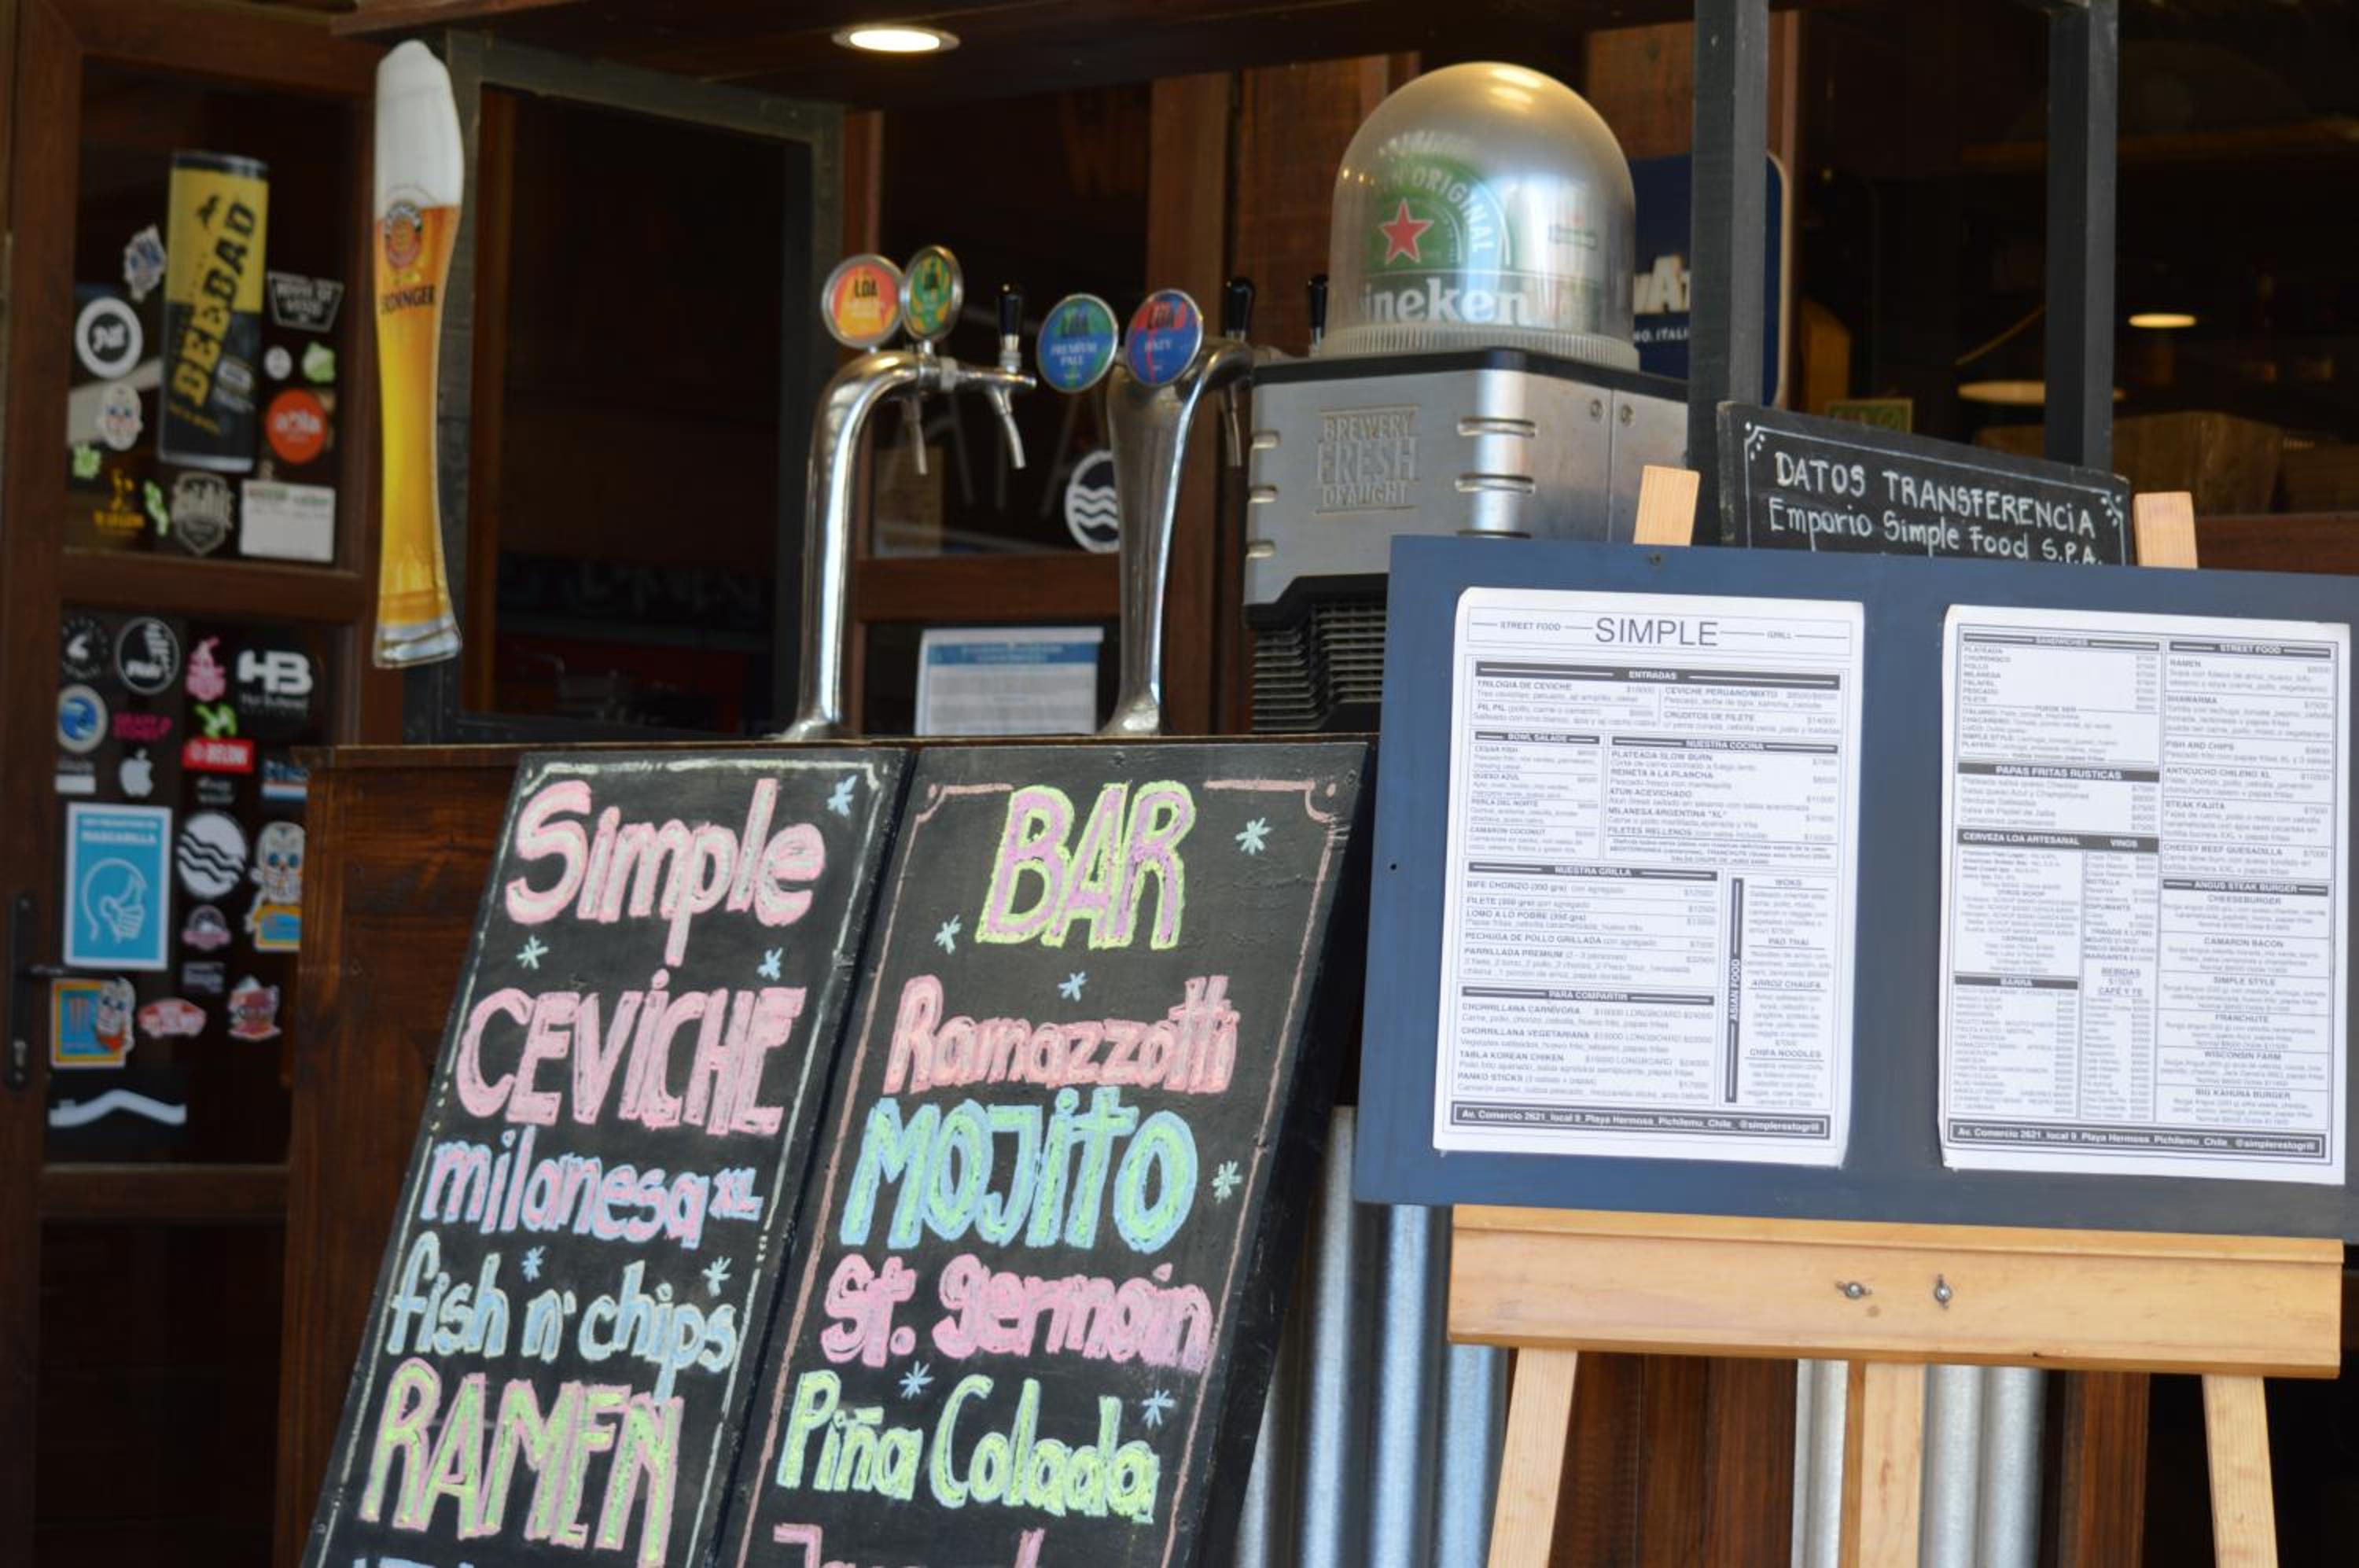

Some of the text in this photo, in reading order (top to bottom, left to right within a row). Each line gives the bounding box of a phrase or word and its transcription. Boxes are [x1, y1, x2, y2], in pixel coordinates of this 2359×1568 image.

[1411, 167, 1493, 252] ORIGINAL
[854, 278, 878, 299] LOA
[1323, 412, 1411, 441] BREWERY
[1316, 436, 1419, 484] FRESH
[1775, 451, 1866, 498] DATOS
[1322, 481, 1409, 506] DRAUGHT
[1883, 510, 1960, 558] Simple
[1970, 526, 2029, 561] Food
[1500, 621, 1533, 631] STREET
[1536, 622, 1560, 631] FOOD
[1595, 617, 1720, 646] SIMPLE
[2219, 644, 2282, 654] STREET FOOD
[1628, 670, 1678, 681] ENTRADAS
[1534, 683, 1573, 691] CEVICHE
[1665, 687, 1703, 696] CEVICHE
[1685, 741, 1765, 751] NUESTRA COCINA
[2208, 742, 2235, 751] CHIPS
[1671, 771, 1714, 780] PLANCHA
[1996, 765, 2122, 780] PAPAS FRITAS RUSTICAS
[2166, 767, 2217, 776] ANTICUCHO
[1963, 832, 2139, 848] CERVEZA LOA ARTESANAL VINOS
[505, 777, 826, 966] Simple
[975, 780, 1196, 951] BAR
[1555, 867, 1632, 878] NUESTRA GRILLA
[2195, 882, 2298, 893] ANGUS STEAK BURGER
[2207, 895, 2281, 904] CHEESEBURGER
[1525, 934, 1554, 943] POLLO
[1556, 936, 1601, 945] GRILLADA
[2204, 937, 2284, 948] CAMARON BACON
[1730, 958, 1740, 990] FOOD
[2214, 977, 2276, 986] SIMPLE STYLE
[1549, 990, 1628, 1001] PARA COMPARTIR
[882, 974, 1241, 1095] Ramazzotti
[2252, 1091, 2291, 1100] BURGER
[1478, 1110, 1522, 1121] Comercio
[1585, 1113, 1610, 1125] Playa
[1974, 1128, 2018, 1139] Comercio
[2081, 1133, 2106, 1143] Playa
[419, 1125, 710, 1249] milanesa
[385, 1231, 510, 1358] fish
[578, 1259, 738, 1406] chips
[776, 1370, 1161, 1524] Piña Colada
[359, 1357, 684, 1568] RAMEN
